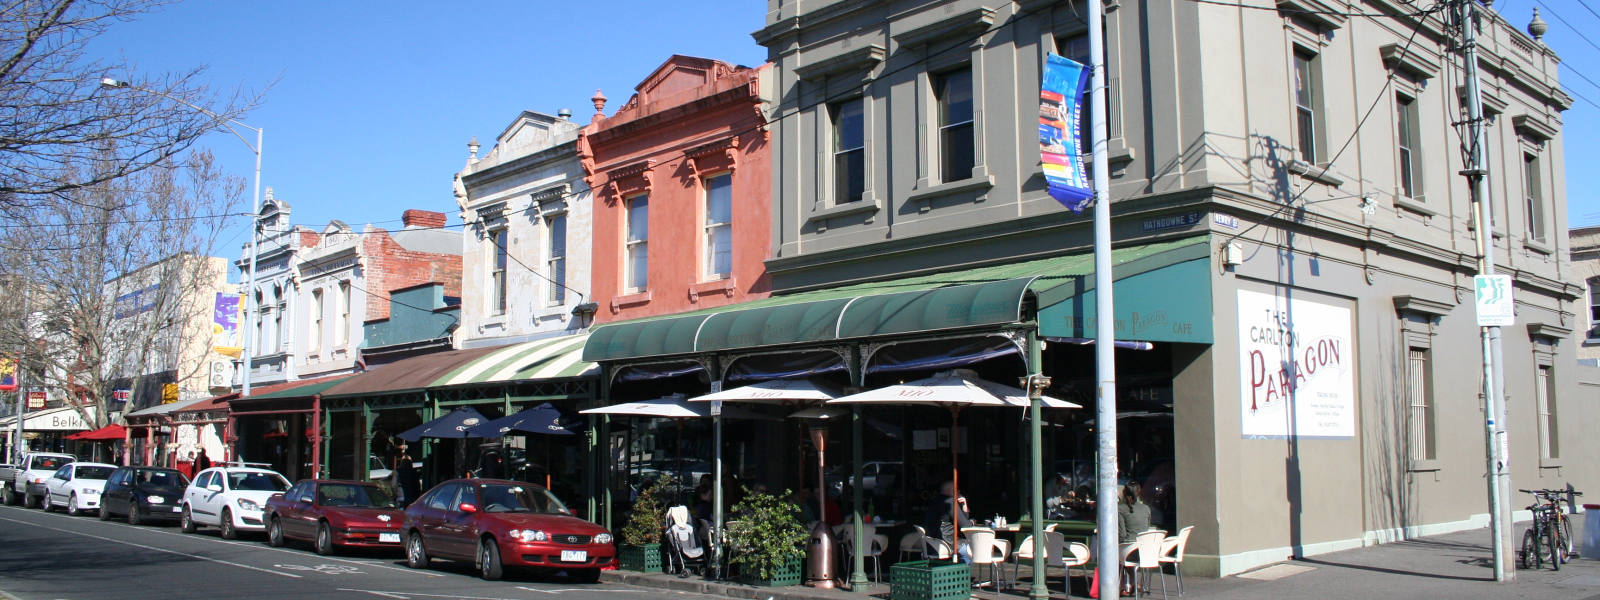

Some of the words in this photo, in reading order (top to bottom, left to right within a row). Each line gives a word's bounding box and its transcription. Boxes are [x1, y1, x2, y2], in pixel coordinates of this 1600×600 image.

[1073, 102, 1081, 136] STREET
[1073, 138, 1089, 188] RATHDOWNE
[1265, 309, 1287, 326] THE
[1250, 326, 1299, 348] CARLTON
[1249, 338, 1340, 412] PARAGON
